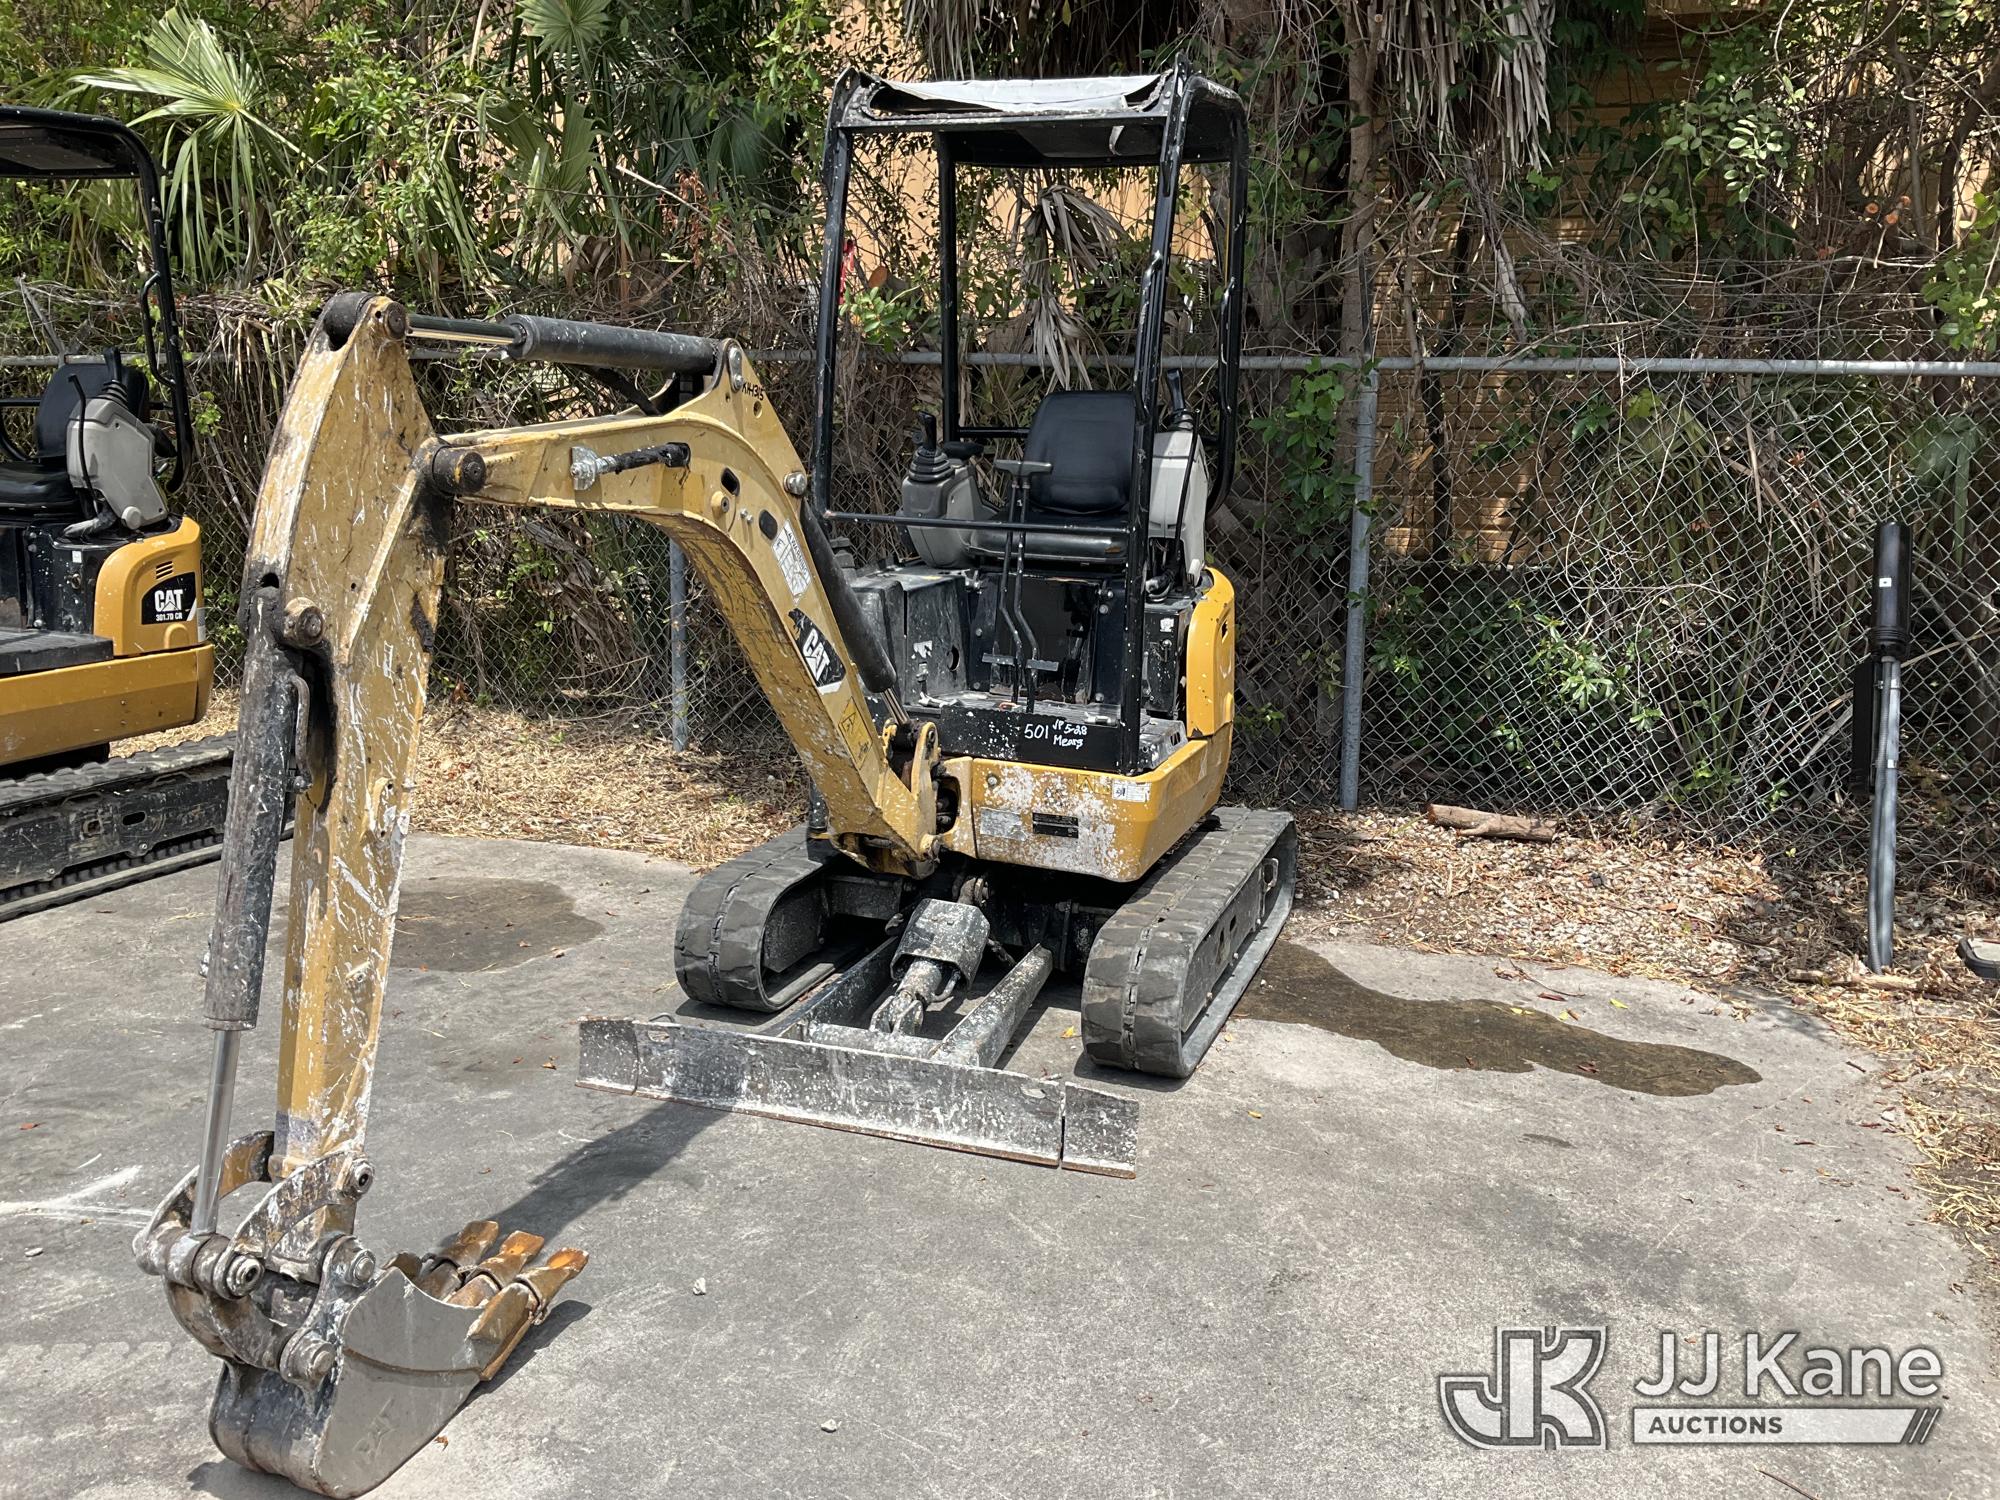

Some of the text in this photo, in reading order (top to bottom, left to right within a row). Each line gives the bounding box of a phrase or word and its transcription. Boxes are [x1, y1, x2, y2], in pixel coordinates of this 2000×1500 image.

[154, 589, 183, 612] CAT
[803, 628, 830, 681] CAT
[1024, 723, 1049, 739] 501
[1063, 723, 1088, 735] 5-28
